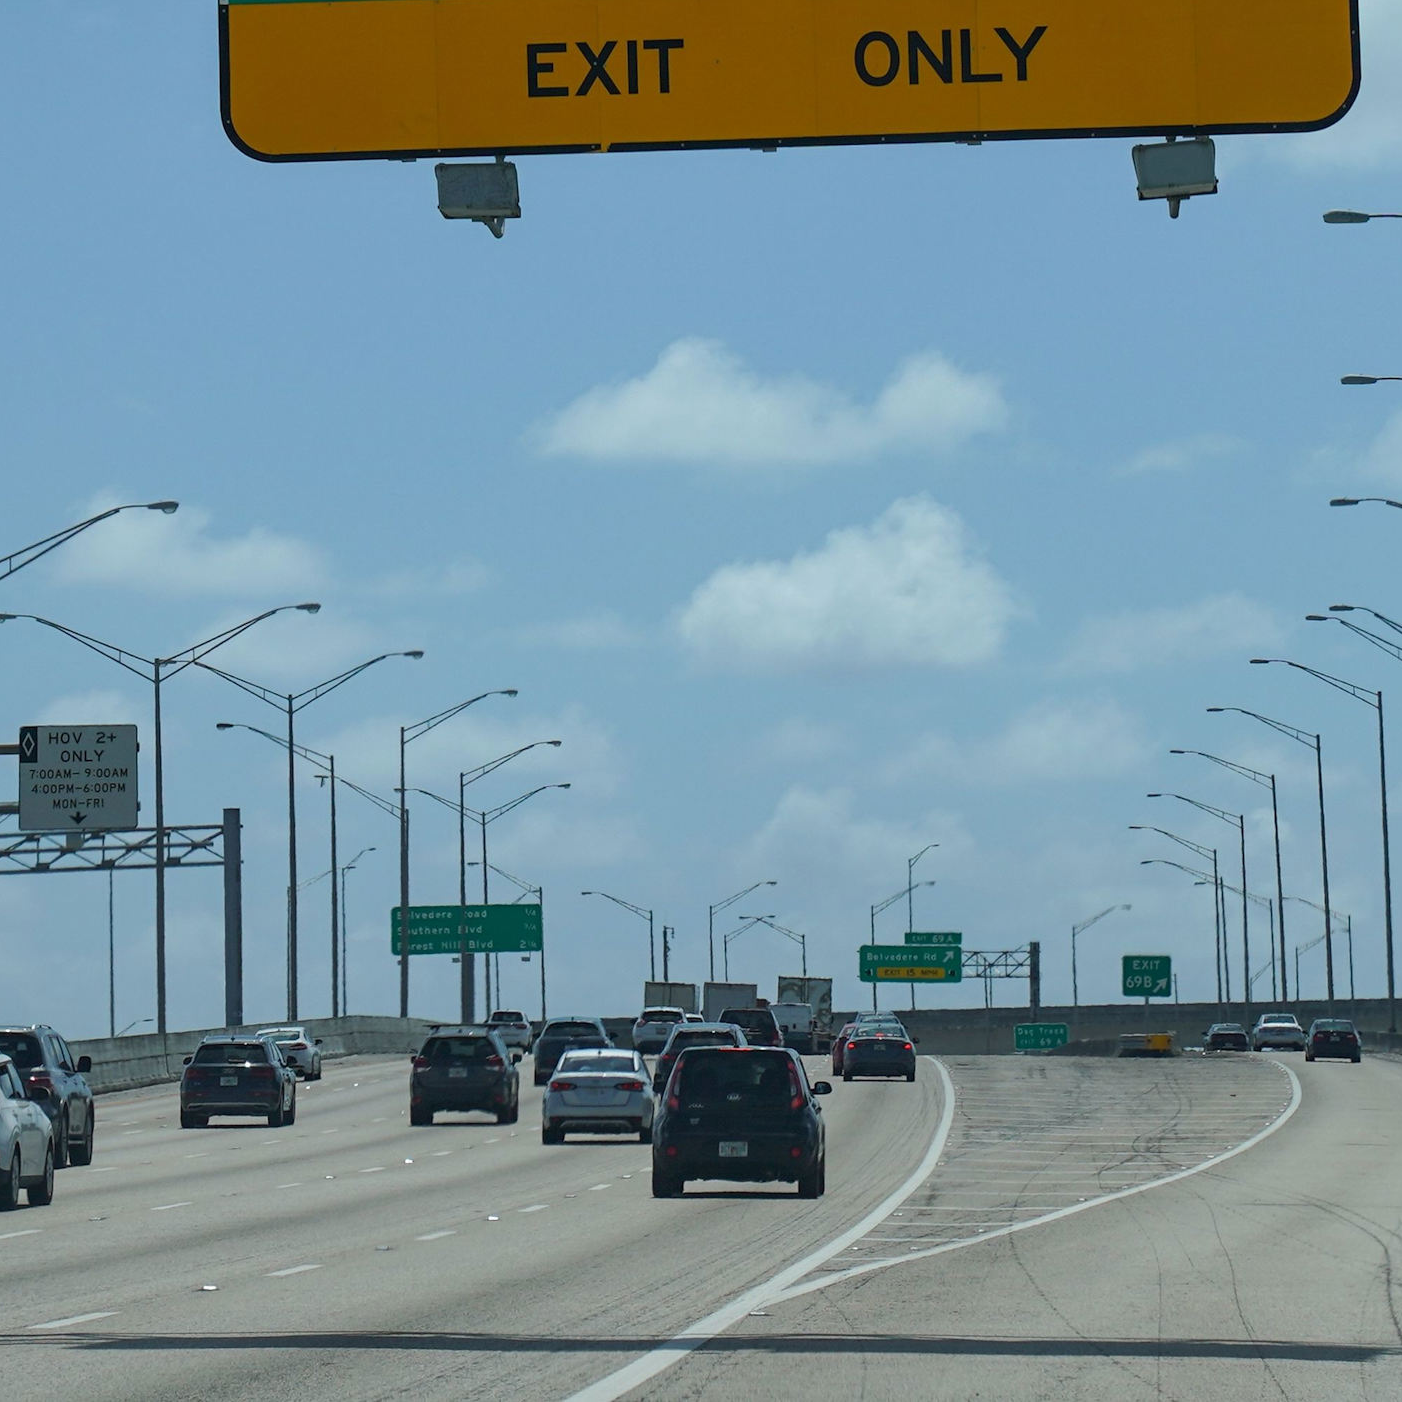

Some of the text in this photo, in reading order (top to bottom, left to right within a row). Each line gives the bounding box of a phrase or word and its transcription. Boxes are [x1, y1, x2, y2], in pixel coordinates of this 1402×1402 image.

[527, 26, 1047, 97] EXIT ONLY
[48, 732, 116, 744] HOV 2+
[60, 750, 104, 762] ONLY
[53, 798, 104, 808] MON-FRI
[397, 911, 452, 919] Blvedere
[469, 940, 493, 948] Blvd
[867, 952, 937, 961] Belvedere Rd
[1132, 960, 1160, 970] EXIT
[1126, 976, 1152, 988] 69B
